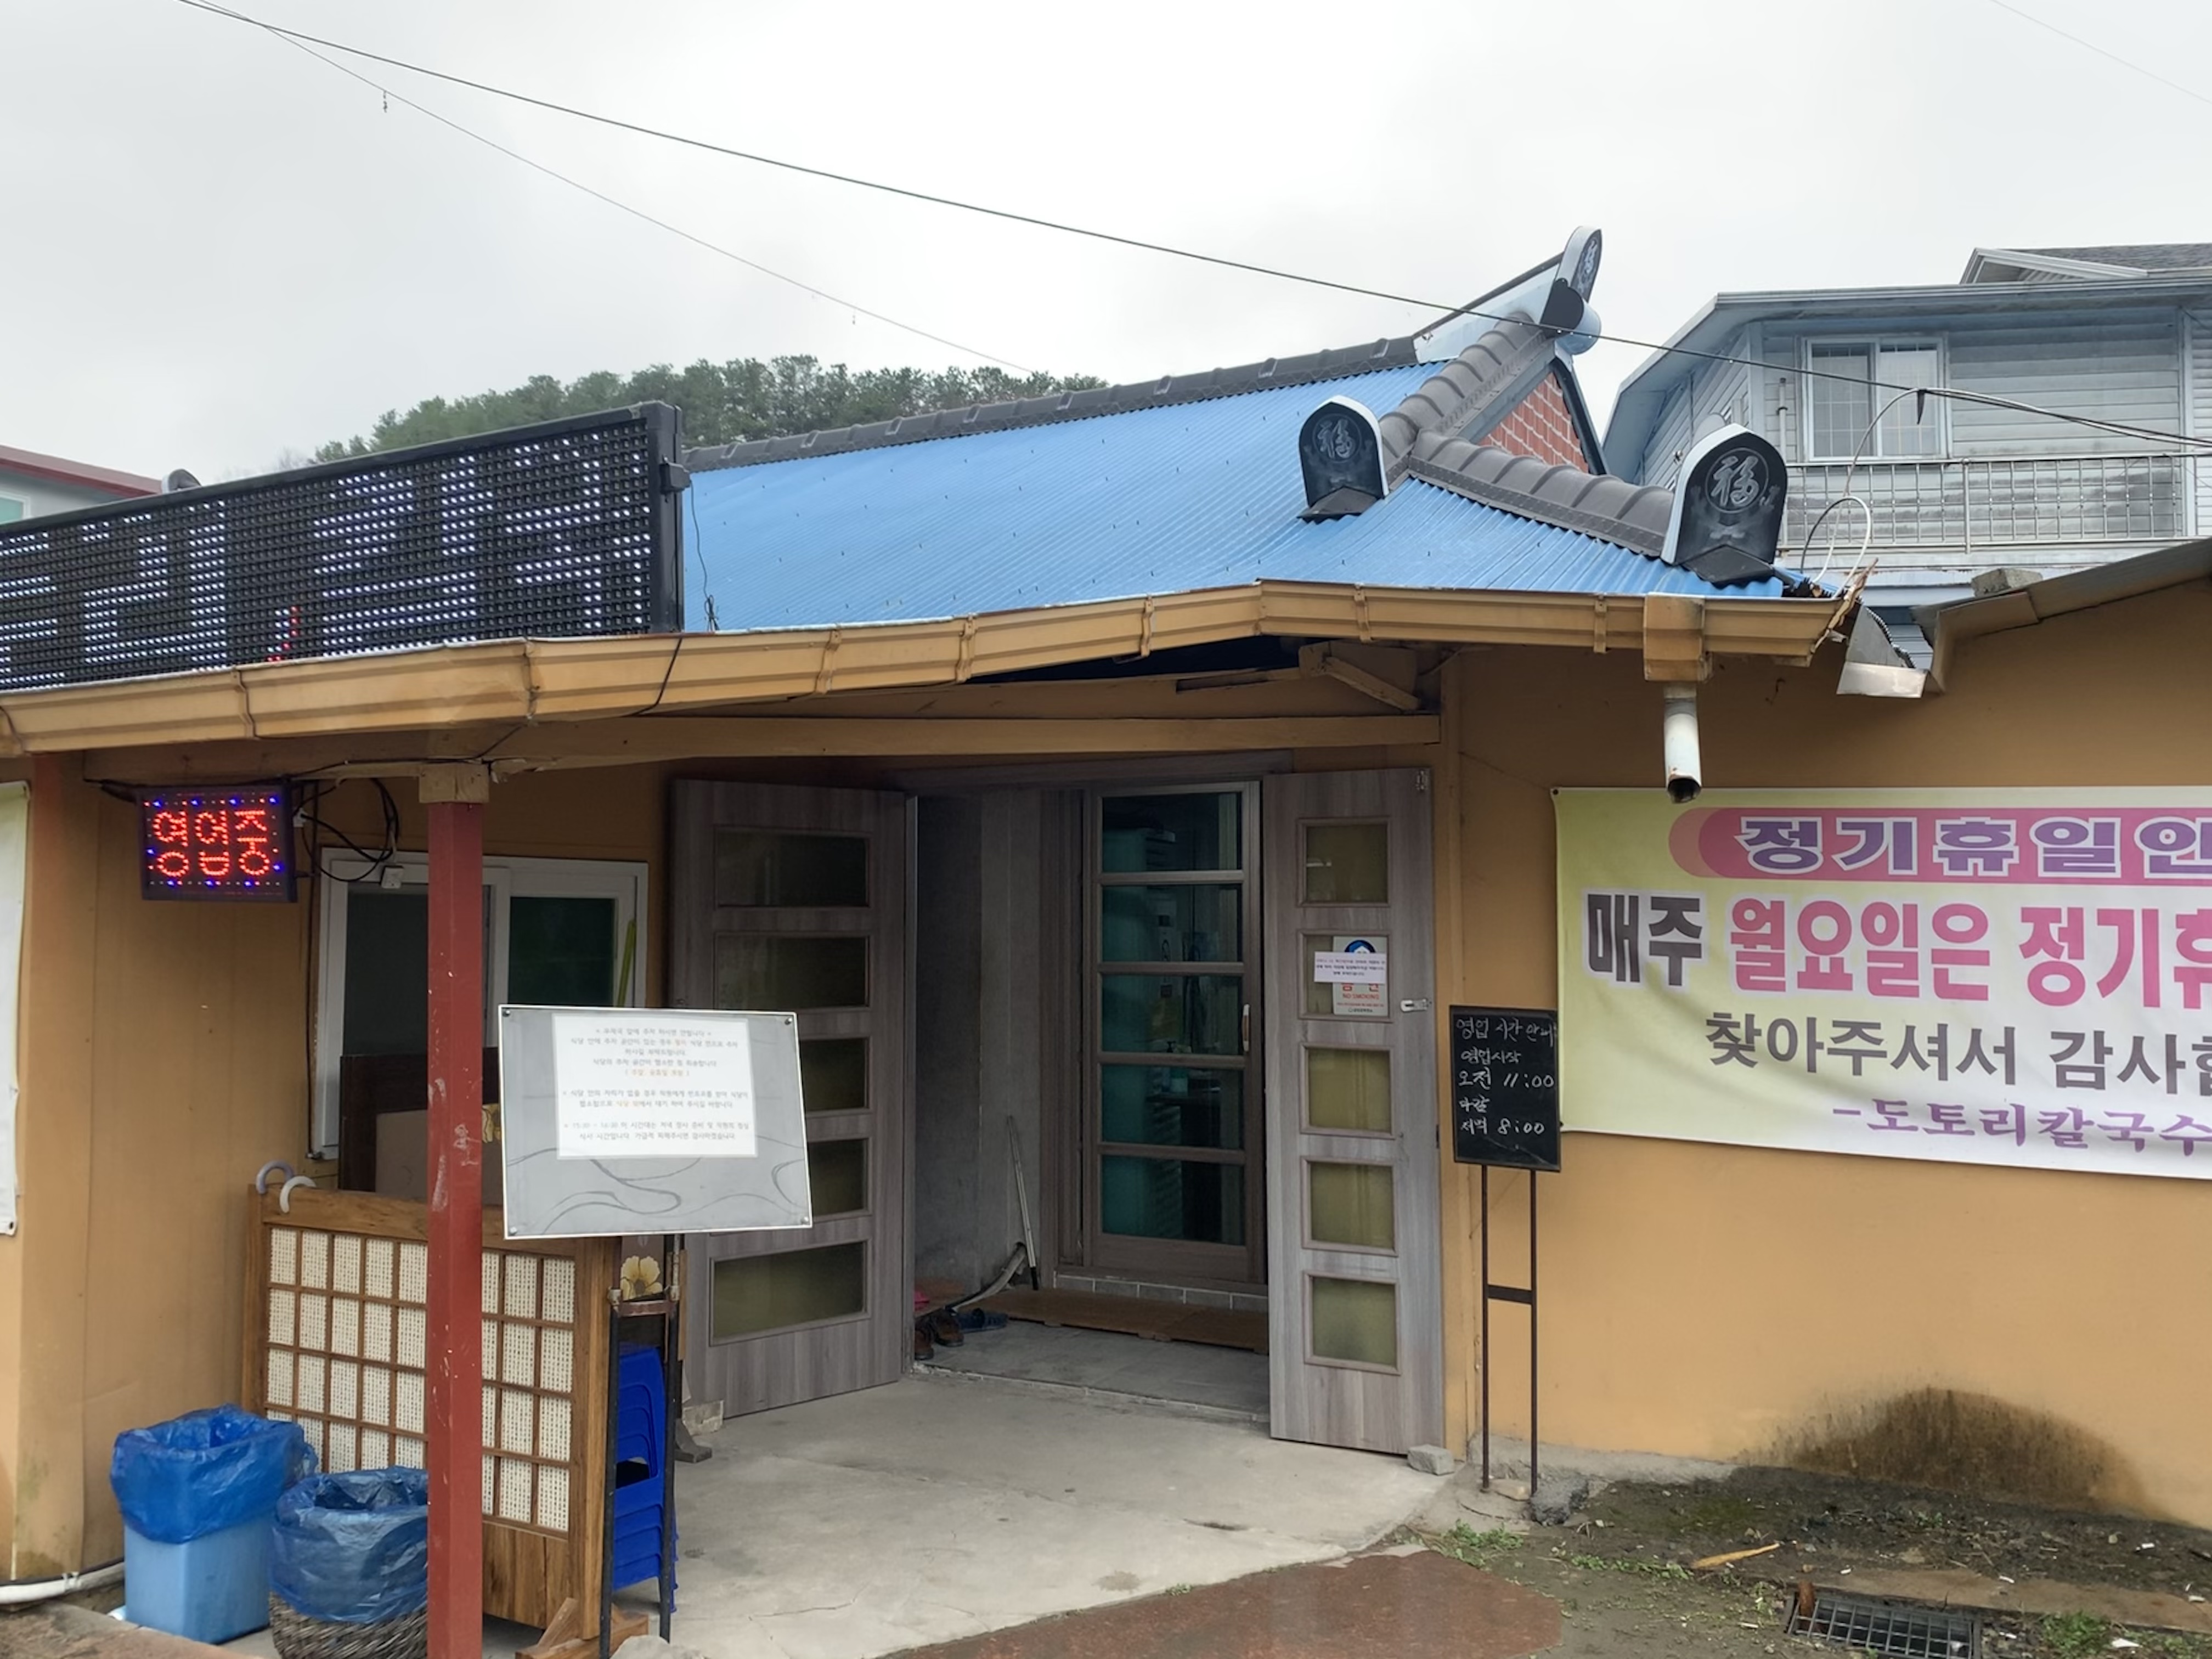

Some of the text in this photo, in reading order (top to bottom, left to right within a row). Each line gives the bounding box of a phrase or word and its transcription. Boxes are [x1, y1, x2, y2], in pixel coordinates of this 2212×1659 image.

[153, 809, 270, 878] 영업중
[1587, 894, 2212, 1010] 매주 월요일은 정기휴
[1456, 1017, 1489, 1039] 영업
[1496, 1018, 1522, 1042] 시간
[1705, 1011, 2017, 1086] 찾아주셔서
[1458, 1066, 1555, 1090] 오전 11:00
[1459, 1094, 1490, 1113] 마감
[1461, 1118, 1544, 1135] 저녁 8:00
